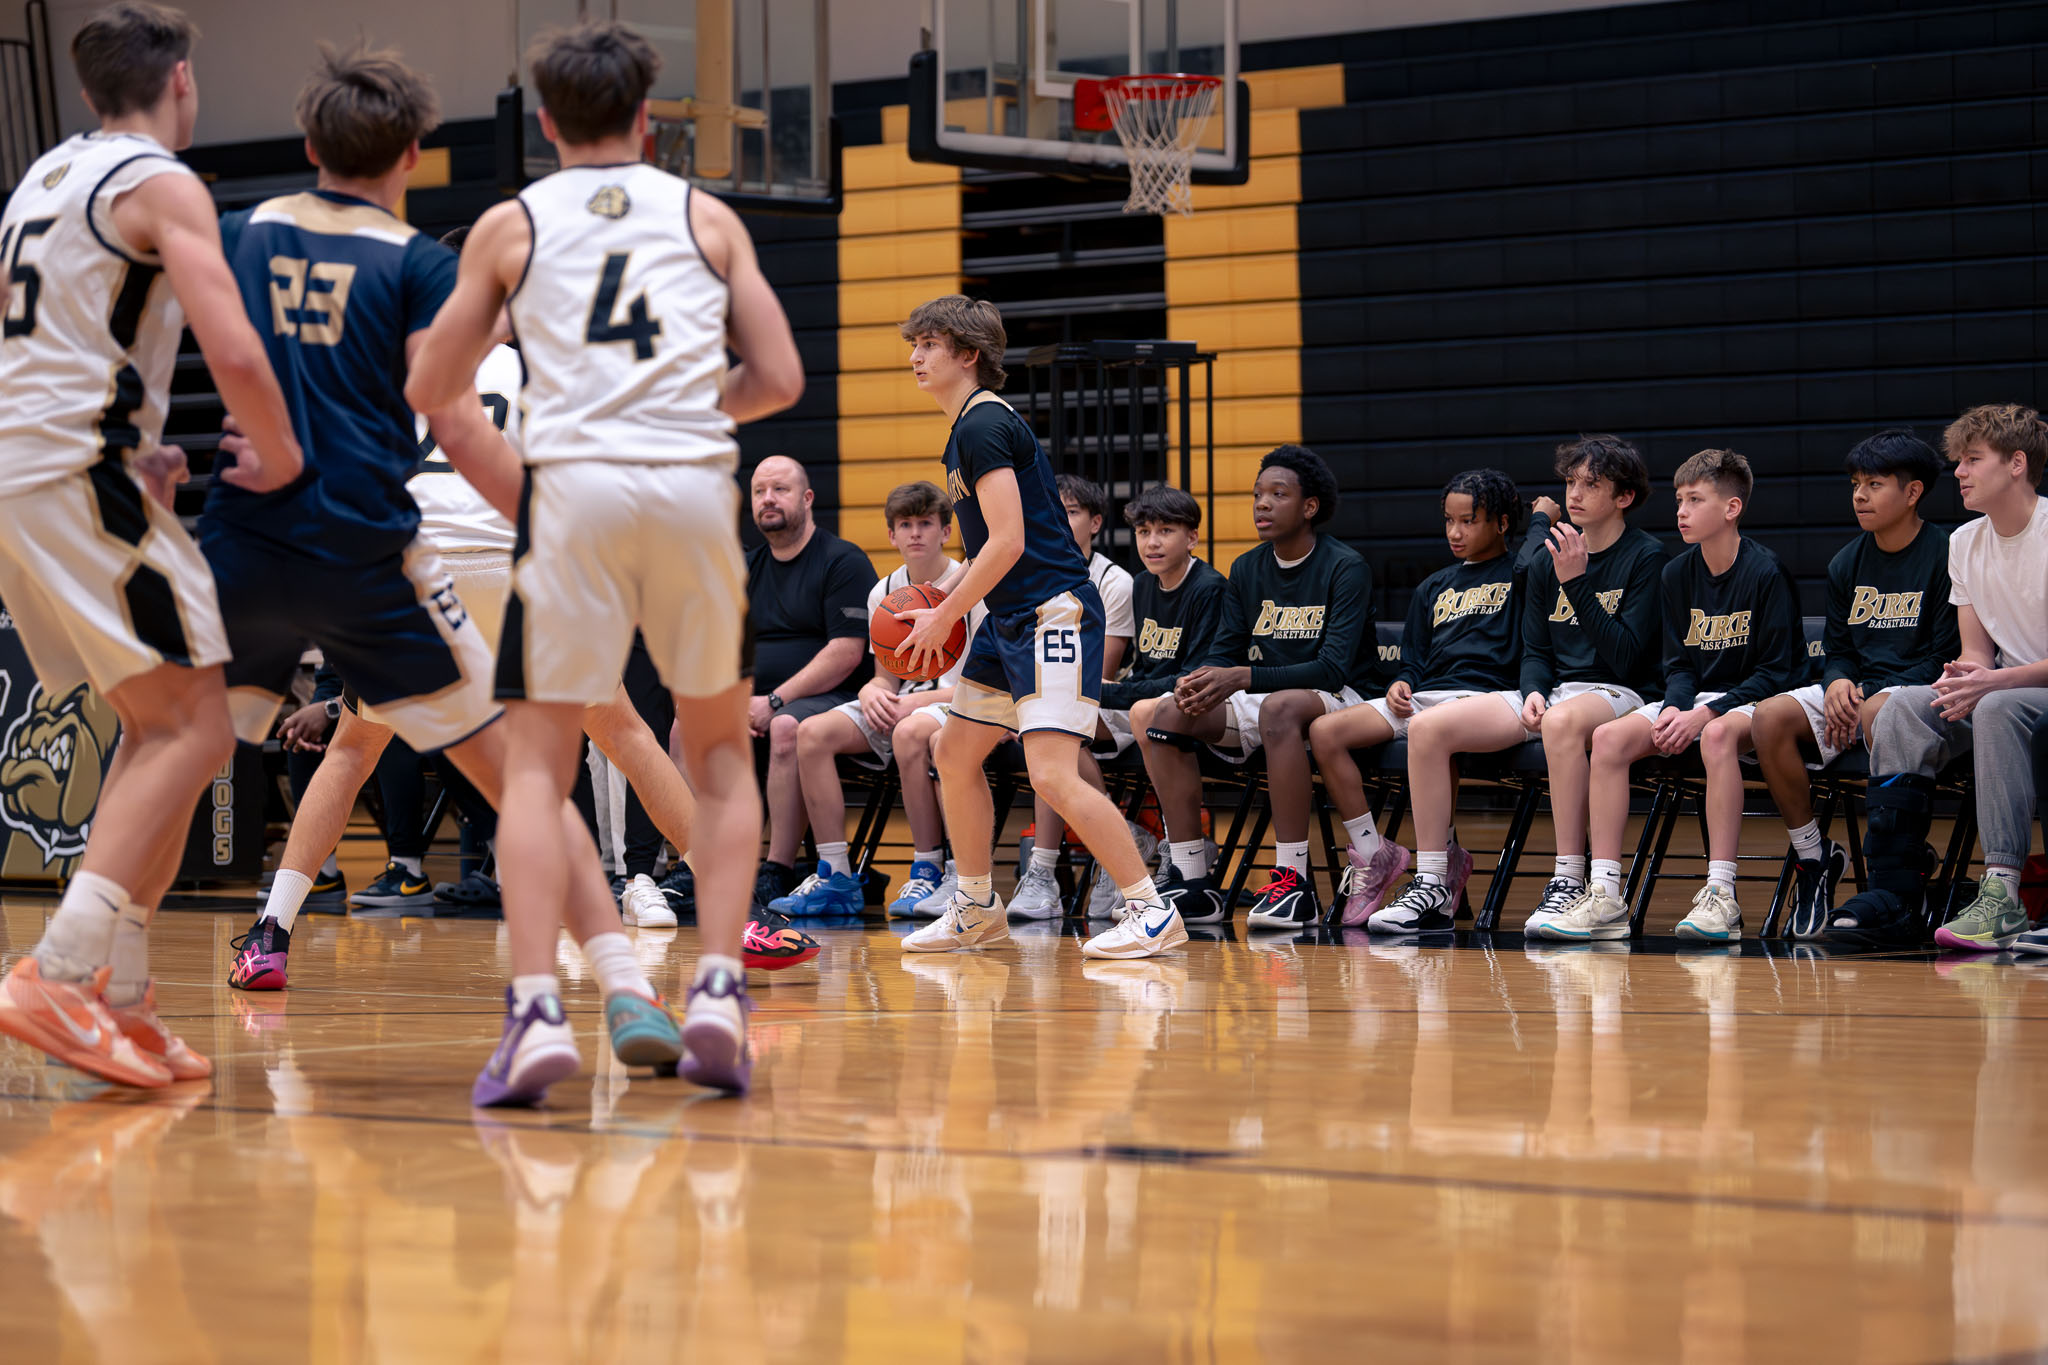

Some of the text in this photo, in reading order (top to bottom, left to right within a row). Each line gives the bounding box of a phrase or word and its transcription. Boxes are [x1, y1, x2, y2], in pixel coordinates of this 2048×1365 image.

[268, 254, 357, 347] 23
[584, 250, 663, 363] 4
[1252, 599, 1326, 636] BURKE
[1433, 582, 1512, 629] BURKE
[1847, 585, 1924, 626] BURKE
[1043, 629, 1076, 664] ES
